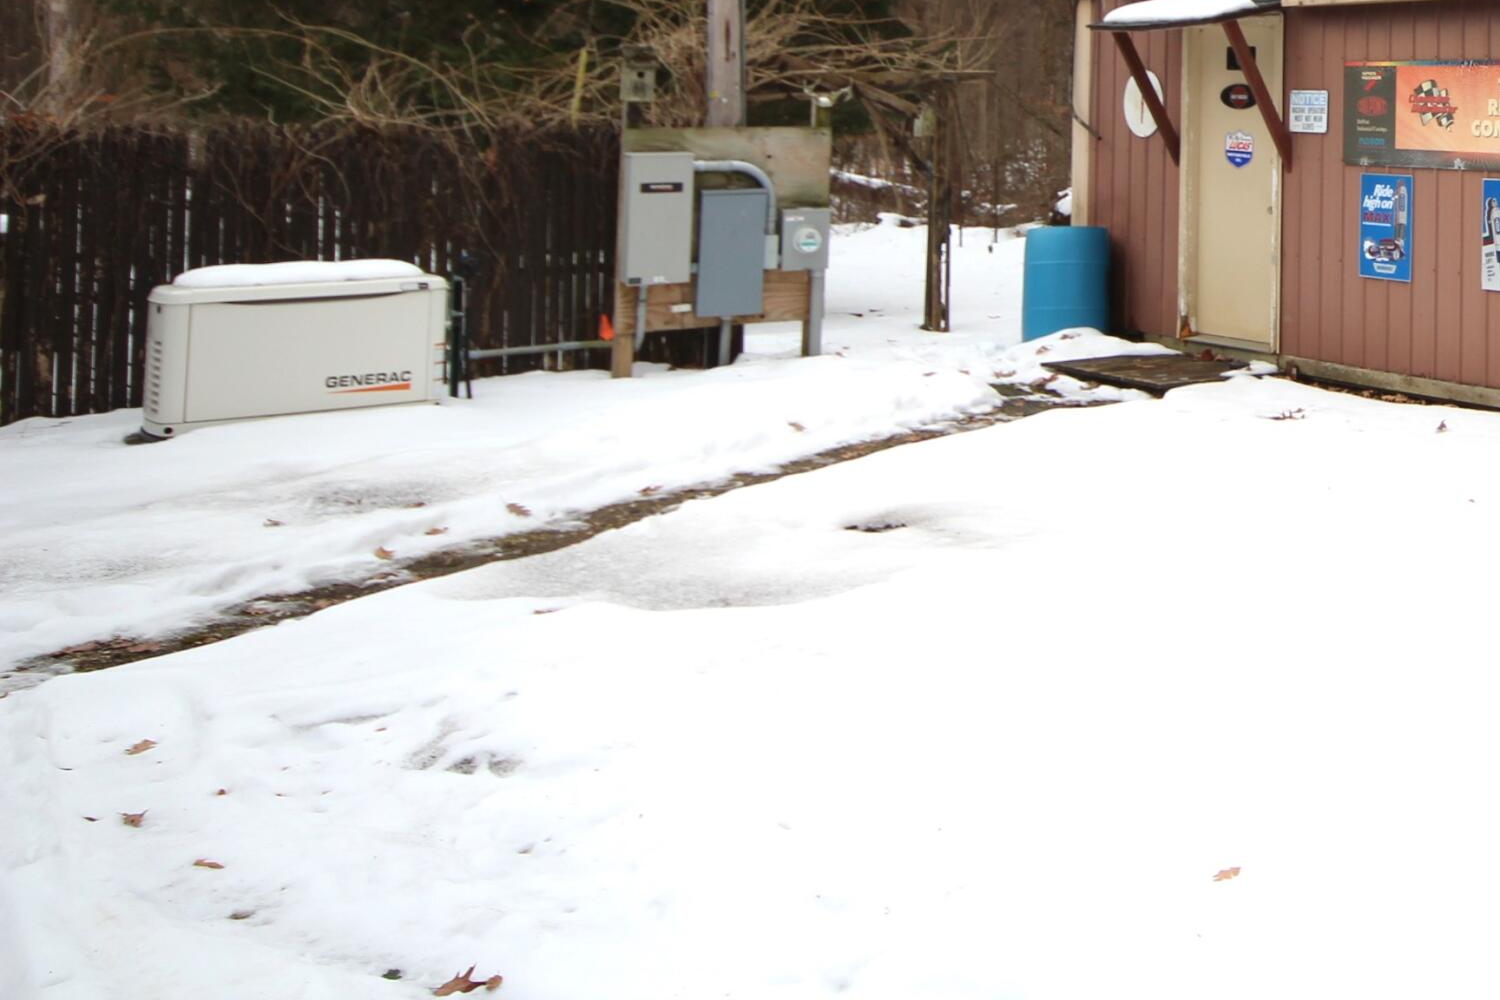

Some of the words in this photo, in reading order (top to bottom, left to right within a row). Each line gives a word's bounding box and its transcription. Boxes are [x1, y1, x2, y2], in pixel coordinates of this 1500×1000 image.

[1292, 93, 1327, 105] NOTICE
[1373, 184, 1394, 198] Ride
[1362, 195, 1381, 211] high
[1381, 200, 1393, 210] on
[325, 371, 412, 388] GENERAC
